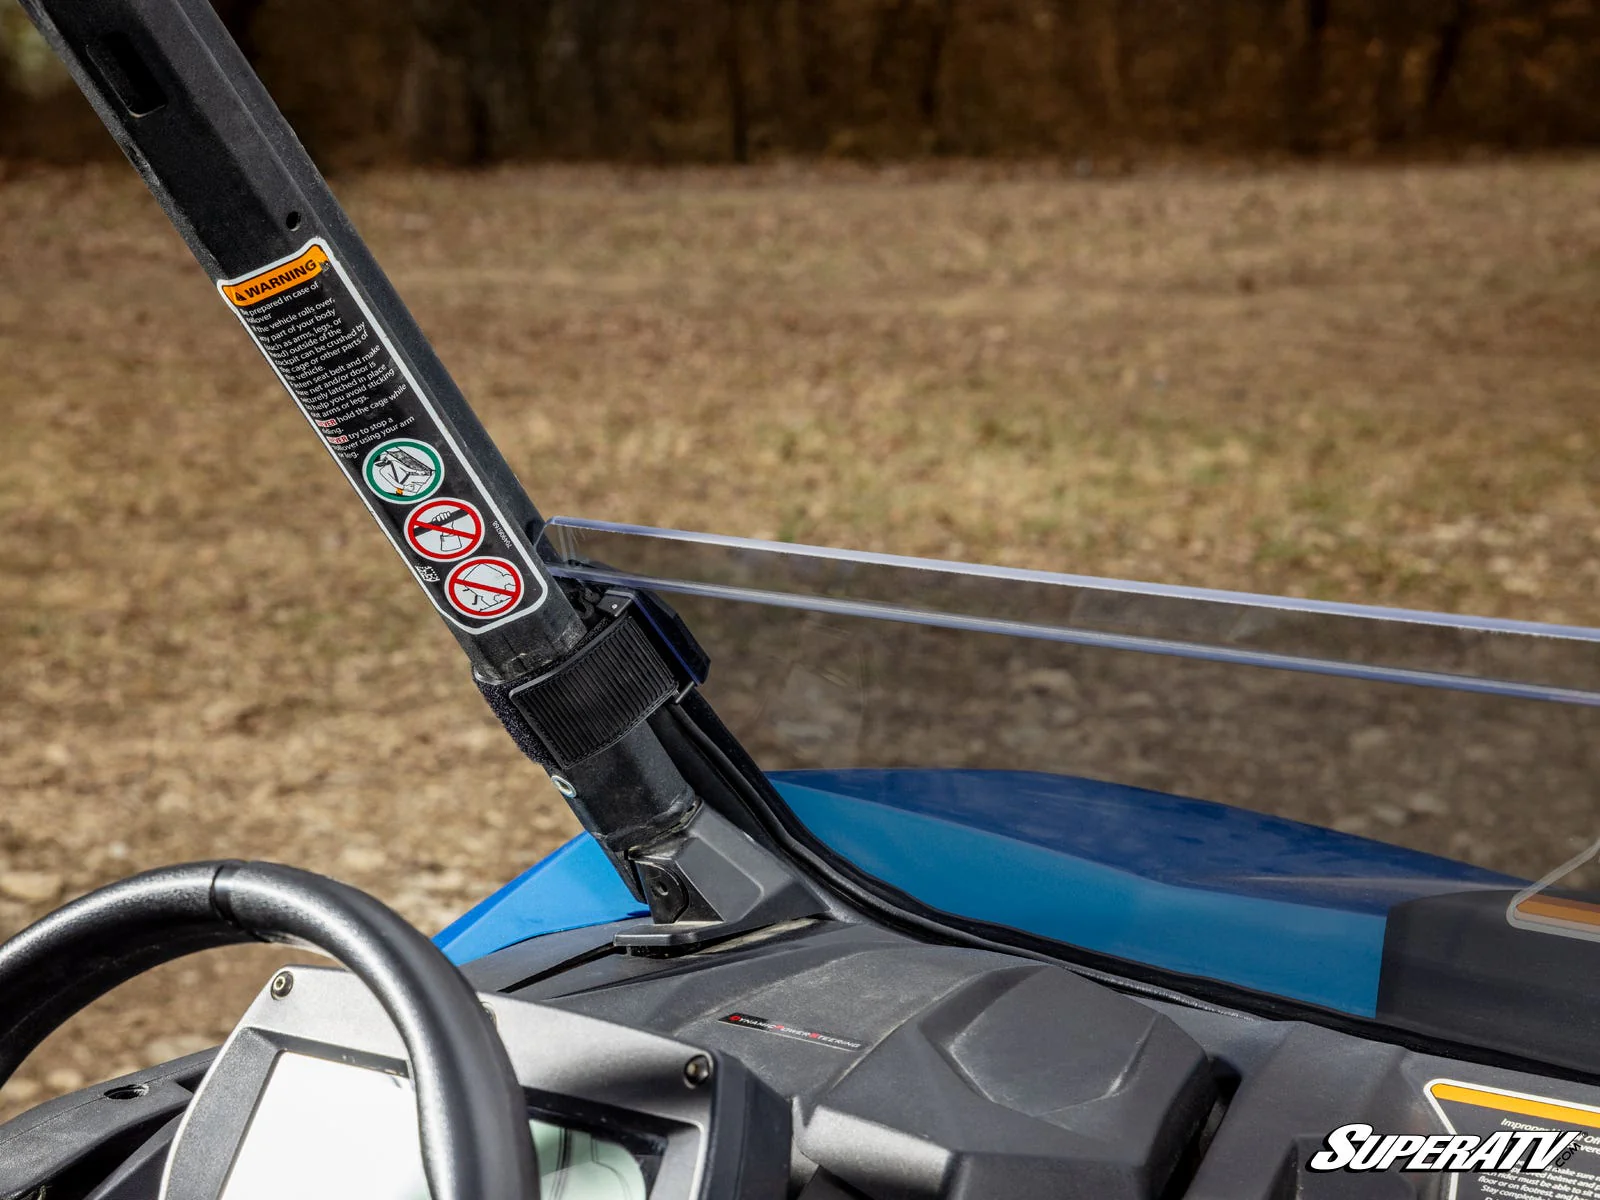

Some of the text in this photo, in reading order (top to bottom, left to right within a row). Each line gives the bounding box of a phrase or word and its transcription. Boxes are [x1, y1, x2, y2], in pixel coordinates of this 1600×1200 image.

[245, 259, 316, 298] WARNING
[249, 298, 284, 316] prepared
[284, 294, 293, 302] in
[292, 288, 310, 298] case
[310, 280, 320, 290] of
[270, 313, 297, 329] vehicle
[298, 306, 315, 318] rolls
[271, 330, 286, 342] part
[288, 324, 297, 333] of
[297, 318, 315, 331] your
[315, 308, 336, 322] body
[293, 331, 315, 343] arms,
[313, 323, 333, 334] legs,
[333, 317, 342, 326] or
[289, 337, 318, 355] outside
[318, 333, 328, 342] of
[328, 327, 342, 337] the
[291, 362, 310, 374] cage
[310, 356, 319, 365] or
[320, 348, 341, 362] other
[341, 338, 361, 352] parts
[361, 329, 369, 340] of
[300, 350, 316, 359] can
[315, 344, 326, 353] be
[326, 329, 357, 348] crushed
[356, 320, 366, 331] by
[296, 365, 326, 380] vehicle.
[312, 372, 329, 383] seat
[329, 364, 346, 376] belt
[346, 357, 361, 369] and
[361, 344, 380, 362] make
[309, 385, 323, 394] net
[324, 374, 349, 389] and/or
[350, 366, 369, 377] door
[312, 400, 330, 411] help
[329, 395, 345, 406] you
[346, 384, 367, 398] avoid
[367, 368, 395, 389] sticking
[328, 379, 358, 396] latched
[366, 364, 387, 380] place
[322, 407, 341, 417] arms
[341, 401, 350, 409] or
[350, 395, 369, 407] legs.
[336, 411, 356, 424] hold
[356, 406, 369, 415] the
[369, 399, 389, 412] cage
[388, 383, 407, 401] while
[348, 432, 360, 441] try
[360, 427, 370, 435] to
[369, 420, 388, 432] stop
[359, 432, 382, 444] using
[381, 423, 400, 437] your
[399, 416, 415, 428] arm
[1517, 1177, 1540, 1185] must
[1547, 1173, 1577, 1185] helmet
[1576, 1172, 1595, 1180] sure
